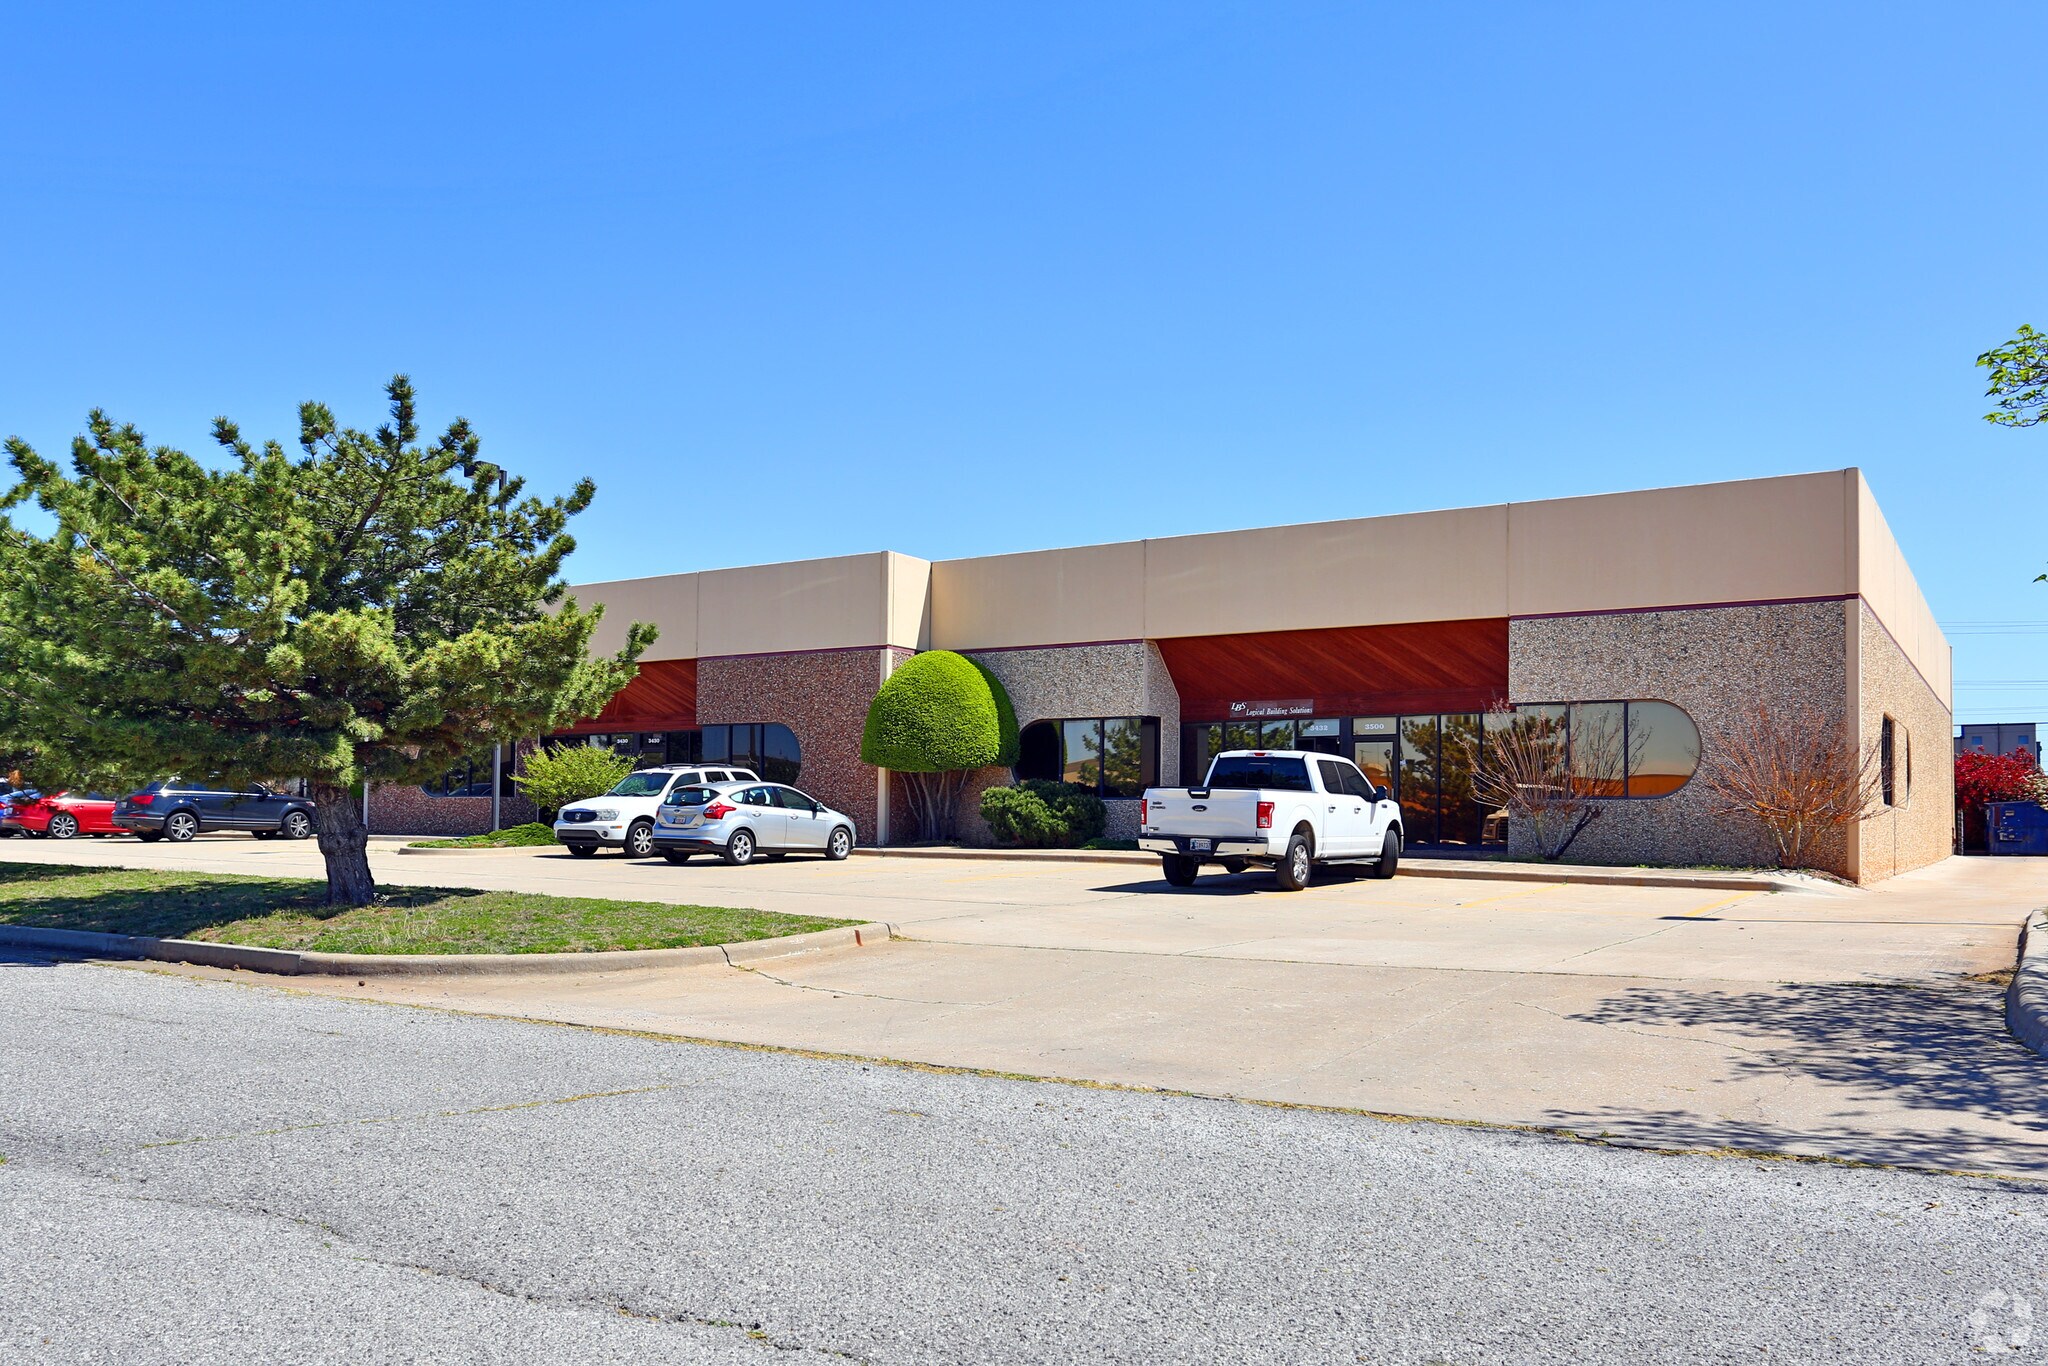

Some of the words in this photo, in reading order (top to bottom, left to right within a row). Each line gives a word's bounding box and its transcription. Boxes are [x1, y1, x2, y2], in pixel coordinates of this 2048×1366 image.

[1231, 702, 1246, 711] LBS
[1246, 708, 1265, 717] Logical
[1266, 707, 1288, 715] Building
[1289, 706, 1313, 714] Solutions
